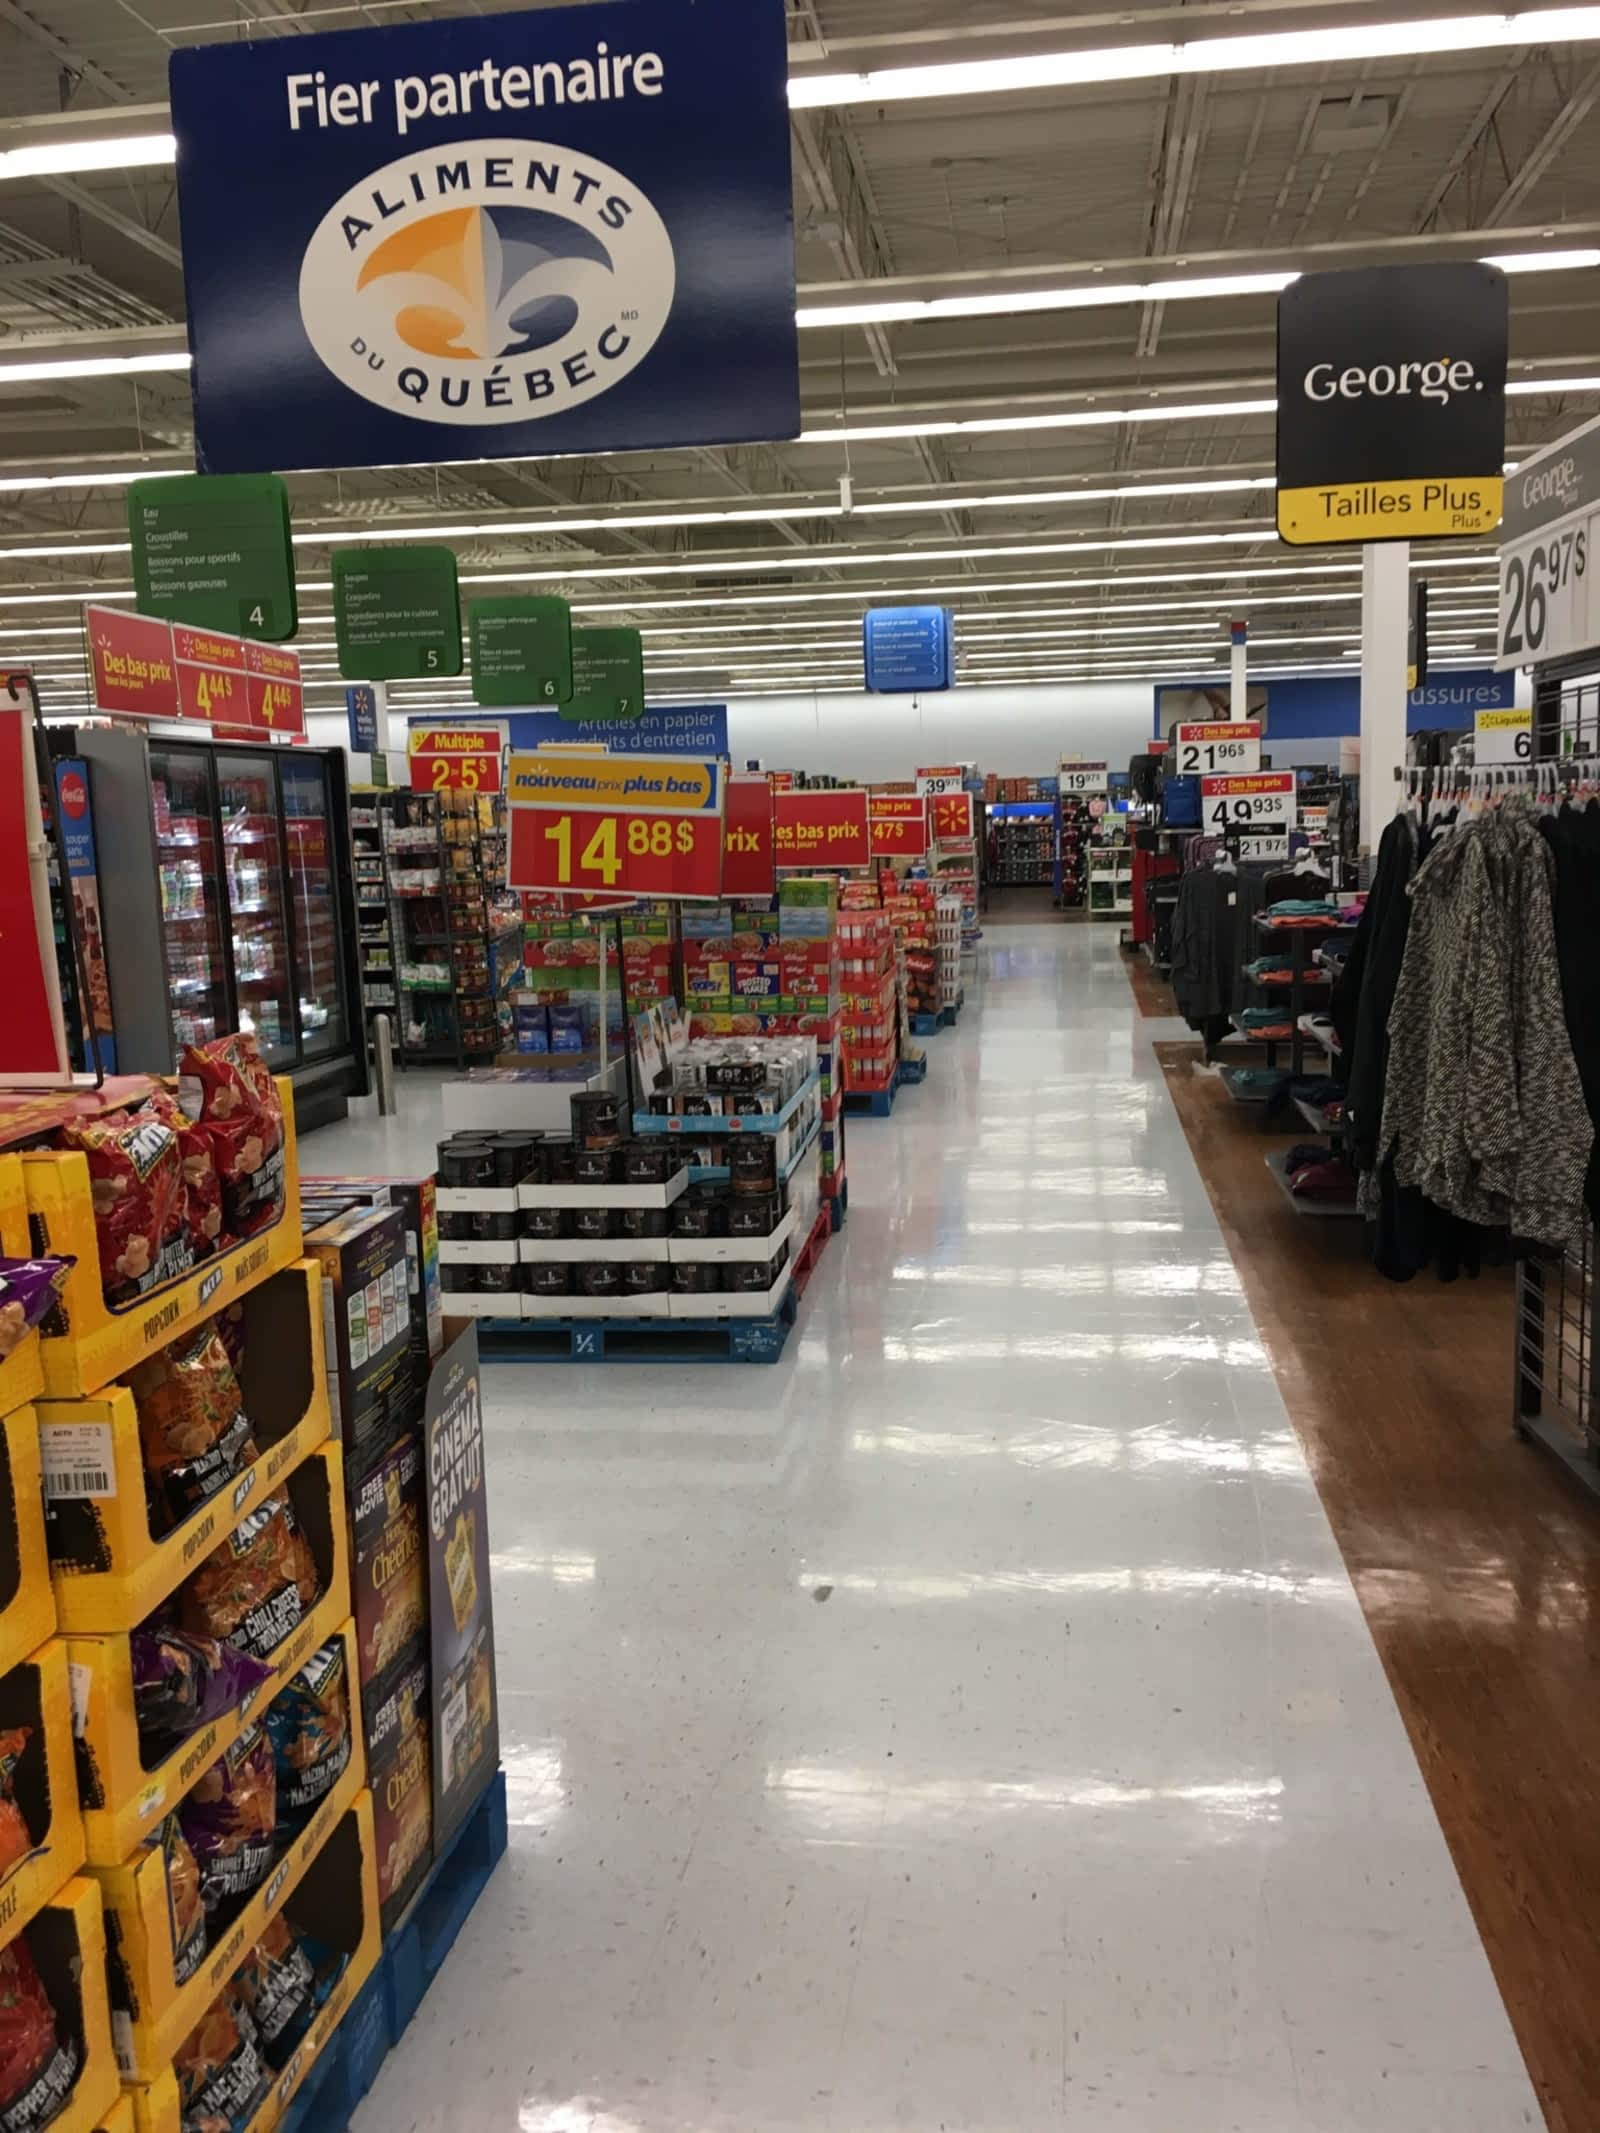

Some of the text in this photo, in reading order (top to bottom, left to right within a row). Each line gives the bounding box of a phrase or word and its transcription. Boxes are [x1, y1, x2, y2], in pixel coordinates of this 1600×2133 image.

[286, 43, 665, 134] Fier partenaire
[339, 157, 633, 250] ALIMENTS
[621, 309, 639, 321] MD
[349, 323, 631, 408] DU QUÉBEC
[1319, 483, 1482, 518] Tailles Plus
[1452, 514, 1481, 529] Plus
[249, 606, 264, 626] 4
[103, 649, 172, 686] Des bas prix
[427, 650, 438, 668] 5
[544, 681, 555, 696] 6
[1410, 685, 1502, 706] ussures
[620, 699, 628, 713] 7
[640, 715, 659, 729] en
[664, 712, 716, 732] papier
[435, 734, 485, 753] Multiple
[432, 759, 450, 791] 2
[515, 773, 596, 789] nouveau
[623, 775, 663, 795] plus
[665, 776, 702, 794] bas
[796, 821, 825, 840] bas
[828, 820, 859, 843] prix
[361, 1472, 384, 1502] FREE
[431, 1431, 481, 1535] GRATUIT
[355, 1488, 385, 1523] MOVIE
[375, 1693, 398, 1725] FREE
[369, 1710, 399, 1749] MOVIE
